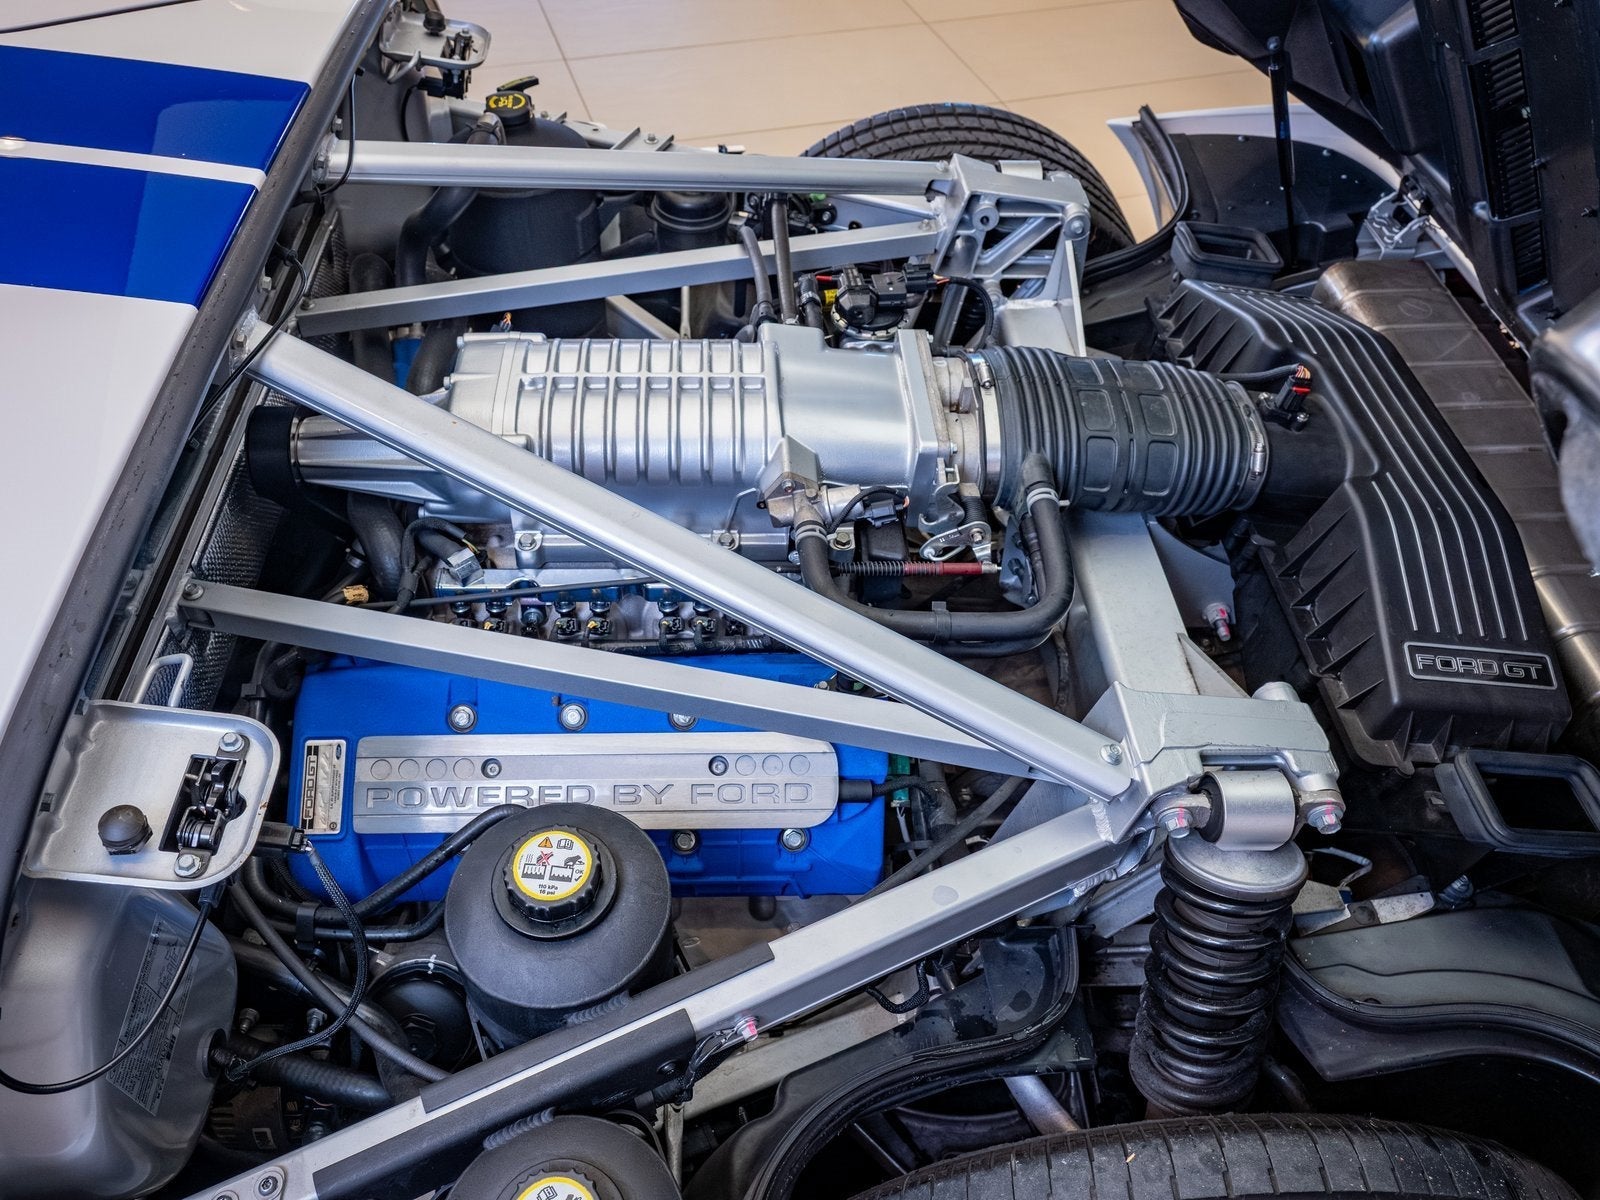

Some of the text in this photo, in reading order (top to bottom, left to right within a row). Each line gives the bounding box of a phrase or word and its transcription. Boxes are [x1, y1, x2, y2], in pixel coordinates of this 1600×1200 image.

[1415, 653, 1543, 680] FORD GT
[305, 757, 315, 818] FORD GT
[366, 784, 596, 809] POWERED
[613, 783, 675, 805] BY
[690, 782, 813, 805] FORD
